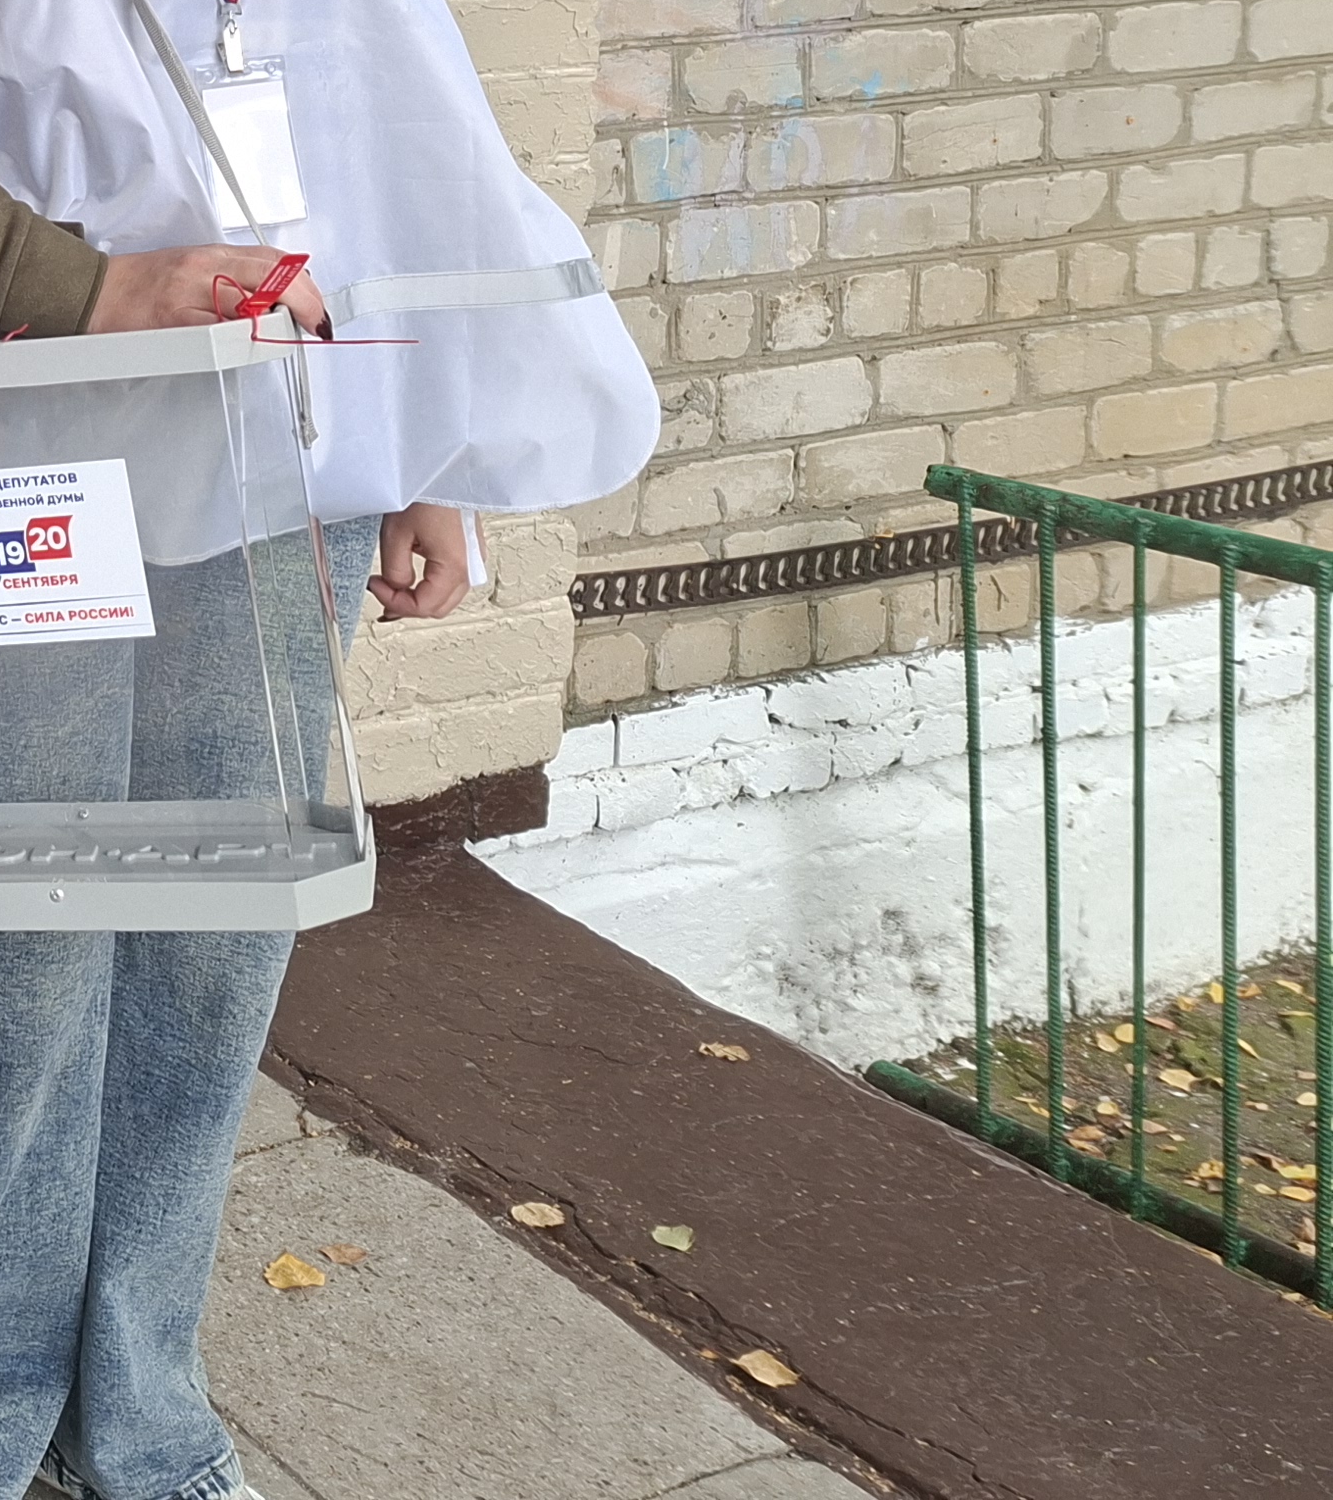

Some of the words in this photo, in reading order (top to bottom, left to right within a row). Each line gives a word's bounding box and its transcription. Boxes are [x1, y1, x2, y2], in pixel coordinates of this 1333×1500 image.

[47, 493, 84, 506] ДУМЫ
[28, 525, 67, 552] 20
[2, 574, 79, 590] СЕНТЯБРЯ
[25, 612, 65, 624] СИЛА
[68, 606, 134, 621] РОССИИ!
